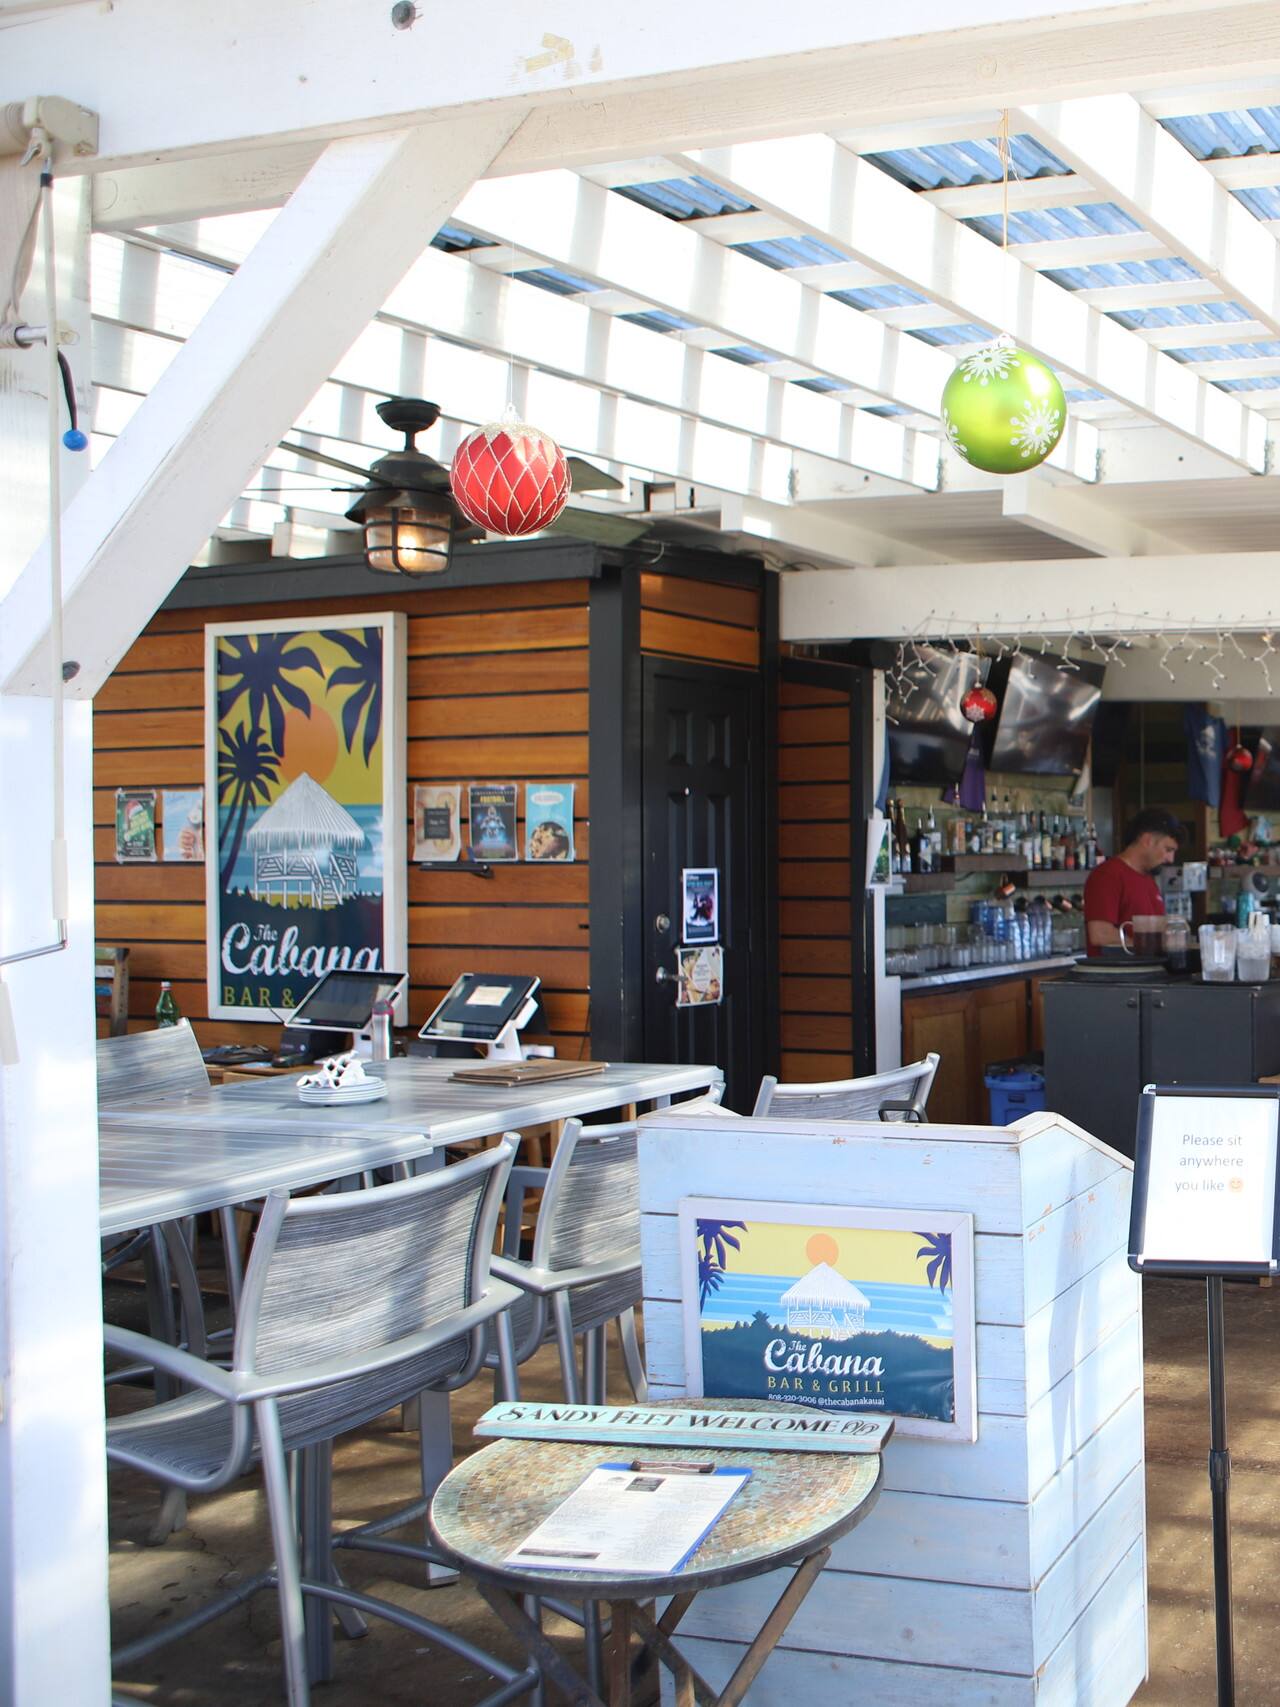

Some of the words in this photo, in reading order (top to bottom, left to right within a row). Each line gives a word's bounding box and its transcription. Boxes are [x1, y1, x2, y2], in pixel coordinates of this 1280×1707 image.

[253, 924, 278, 941] The
[222, 922, 382, 977] Cabana
[224, 985, 271, 1007] BAR
[282, 988, 295, 1008] &
[1182, 1134, 1224, 1146] Please
[1227, 1135, 1243, 1146] sit
[1179, 1155, 1244, 1168] anywhere
[1174, 1181, 1199, 1192] you
[1202, 1179, 1225, 1191] like
[788, 1340, 807, 1351] The
[764, 1338, 885, 1376] Cabana
[768, 1376, 804, 1390] BAR
[812, 1379, 821, 1391] &
[829, 1379, 885, 1393] GRILL
[817, 1396, 885, 1406] @thecabanakauai
[497, 1406, 607, 1422] SANDY
[608, 1410, 683, 1426] FEET
[689, 1414, 840, 1432] WELCOME
